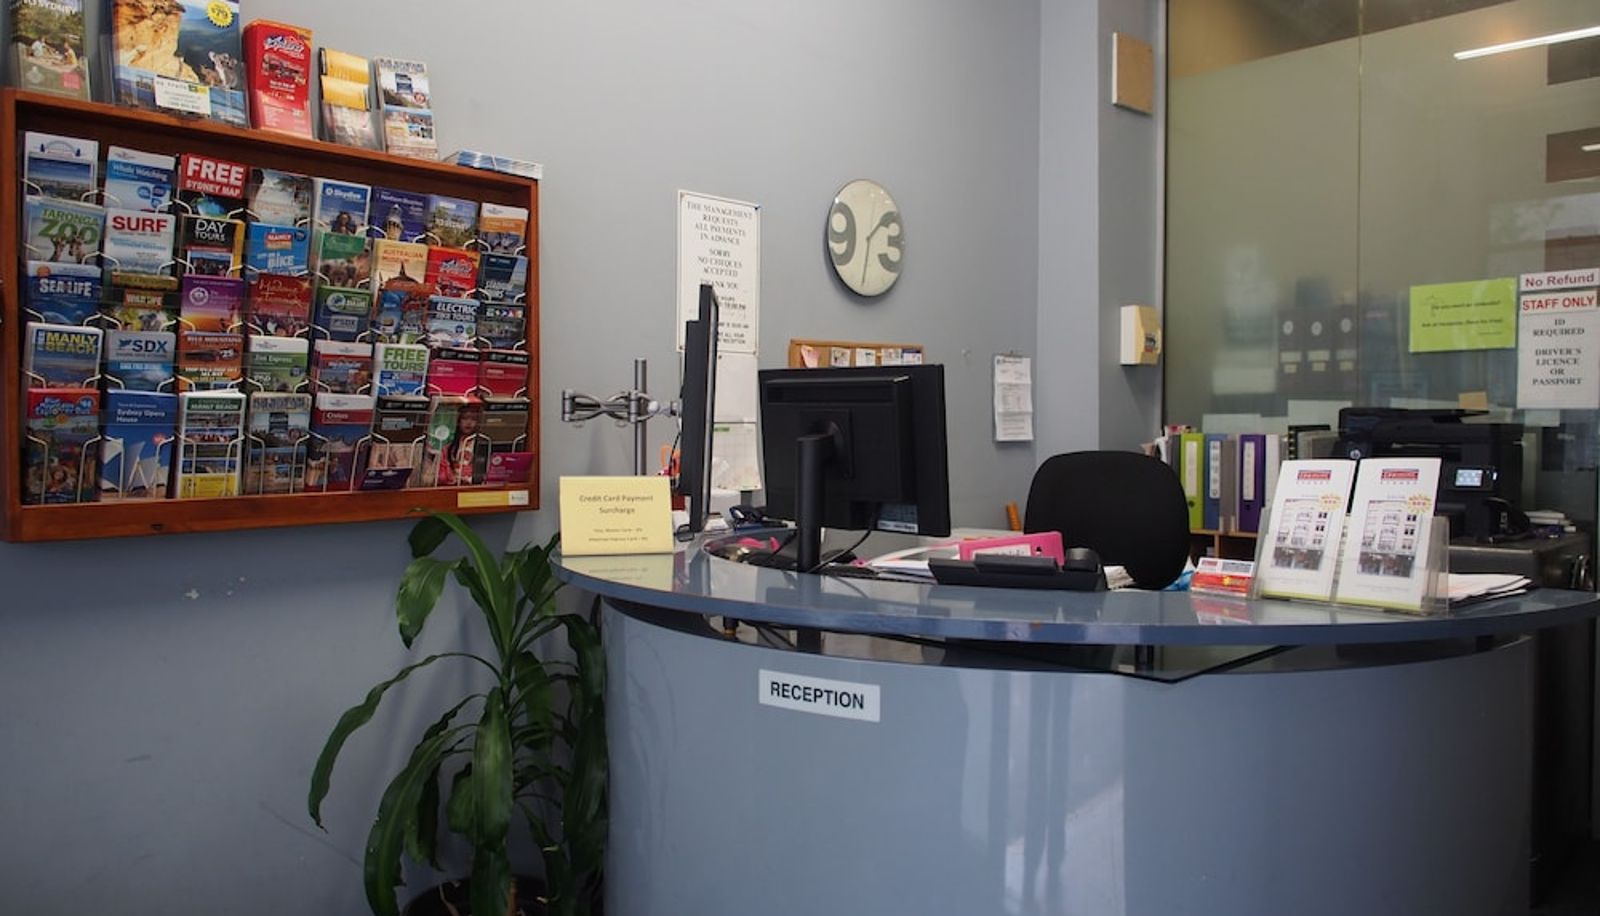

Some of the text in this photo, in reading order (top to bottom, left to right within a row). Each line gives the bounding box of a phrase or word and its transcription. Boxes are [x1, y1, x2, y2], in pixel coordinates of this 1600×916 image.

[187, 157, 244, 186] FREE
[186, 180, 241, 197] SYDNEY MAP
[42, 208, 99, 225] TARONGA
[687, 201, 752, 219] THE MANAGEMENT
[112, 215, 168, 233] SURF
[195, 219, 227, 233] DAY
[703, 214, 738, 226] REQUESTS
[38, 218, 98, 245] ZOO
[195, 231, 226, 242] TOURS
[695, 222, 746, 237] ALL PAYMENTS
[829, 201, 857, 266] 9
[711, 235, 740, 245] ADVANCE
[878, 210, 903, 273] 3
[708, 248, 731, 257] SORRY
[697, 255, 742, 269] NO CHEQUES
[704, 266, 738, 277] ACCEPTED
[39, 278, 65, 293] SEA
[1524, 273, 1595, 288] No Refund
[436, 301, 478, 315] ELECTRIC
[1522, 295, 1595, 311] STAFF ONLY
[47, 332, 97, 344] MANLY
[1533, 328, 1585, 337] REQUIRED
[45, 342, 96, 354] BEACH
[132, 339, 168, 353] SDX
[1535, 348, 1582, 356] DRIVER'S
[383, 347, 426, 360] FREE
[383, 360, 425, 371] TOURS
[1536, 358, 1579, 366] LICENCE
[1532, 377, 1582, 386] PASSPORT
[116, 409, 166, 418] Sydney Opera
[622, 495, 654, 503] Payment
[770, 681, 864, 710] RECEPTION
